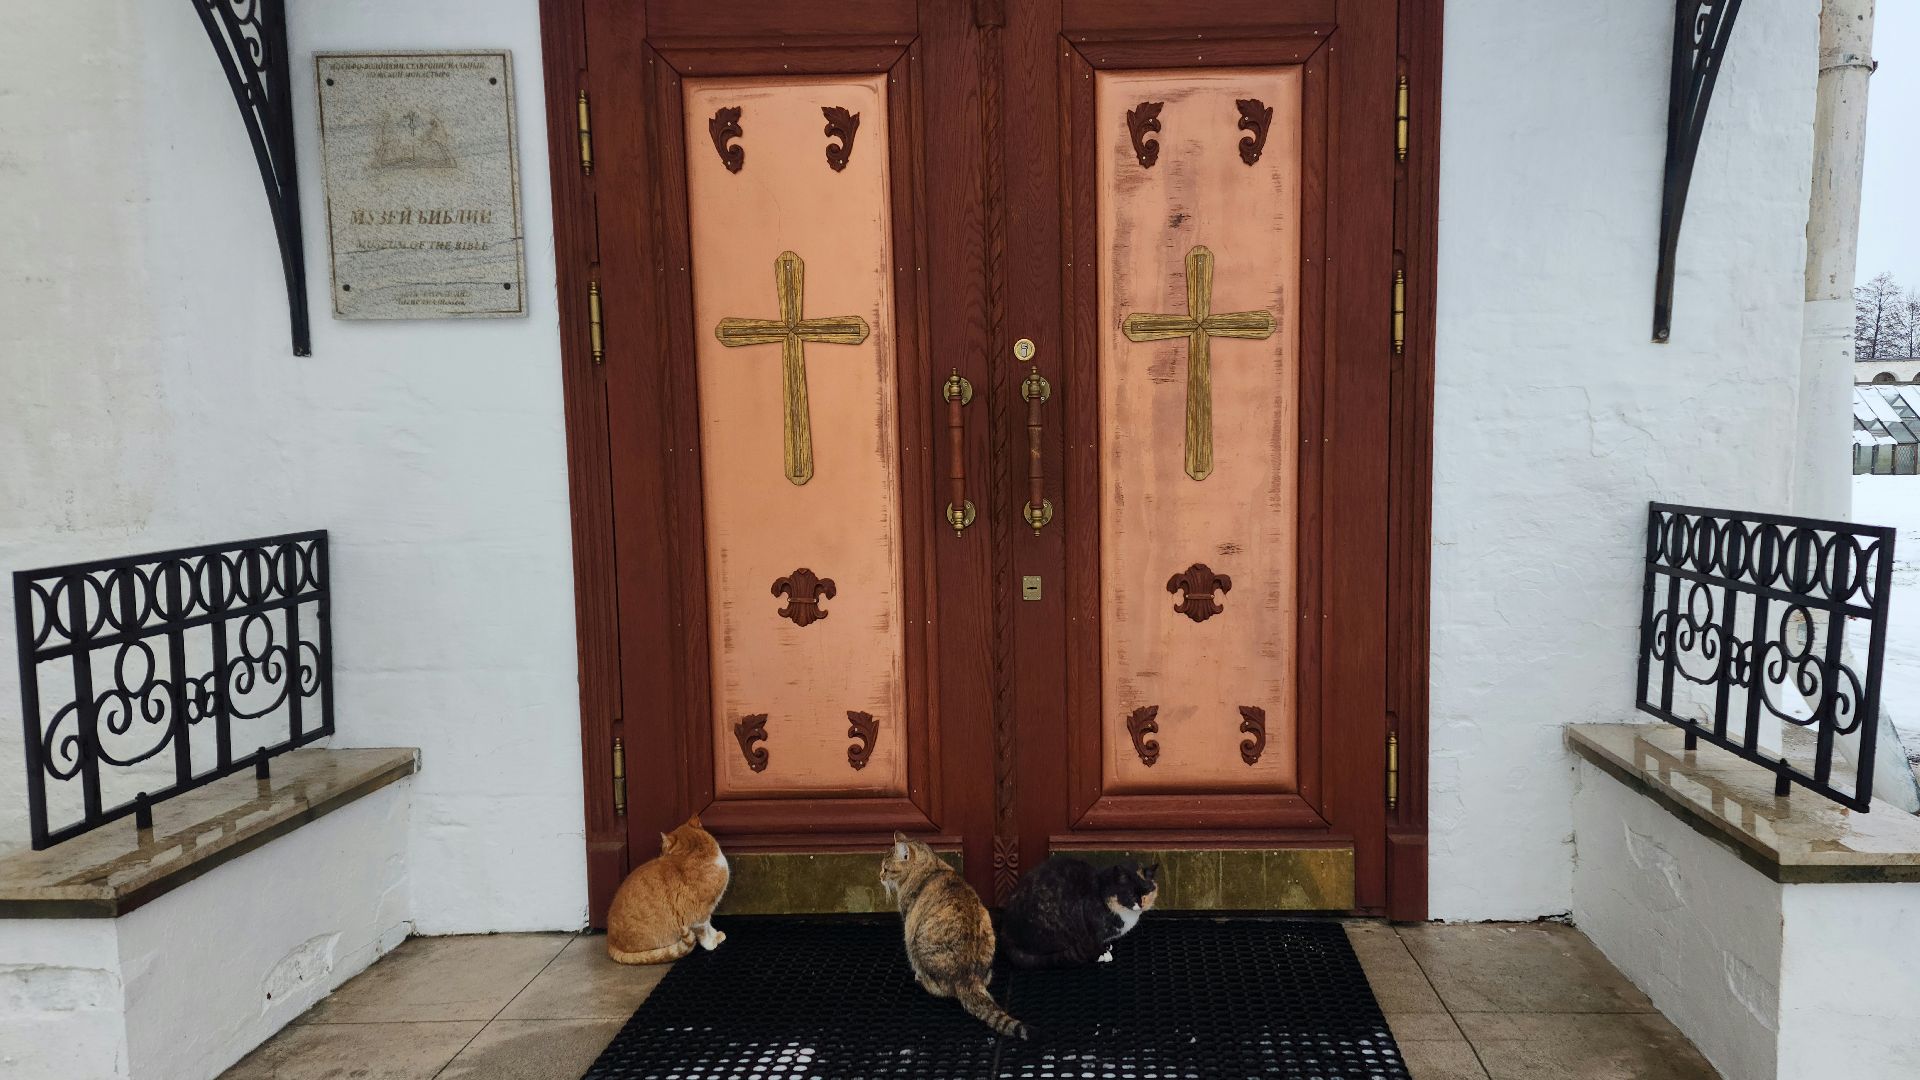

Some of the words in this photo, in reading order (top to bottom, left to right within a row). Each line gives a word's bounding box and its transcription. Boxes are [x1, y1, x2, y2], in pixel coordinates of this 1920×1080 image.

[350, 205, 412, 225] МУЗЕЙ
[410, 240, 425, 250] OF
[428, 240, 451, 250] THE
[454, 240, 489, 251] BIBLE
